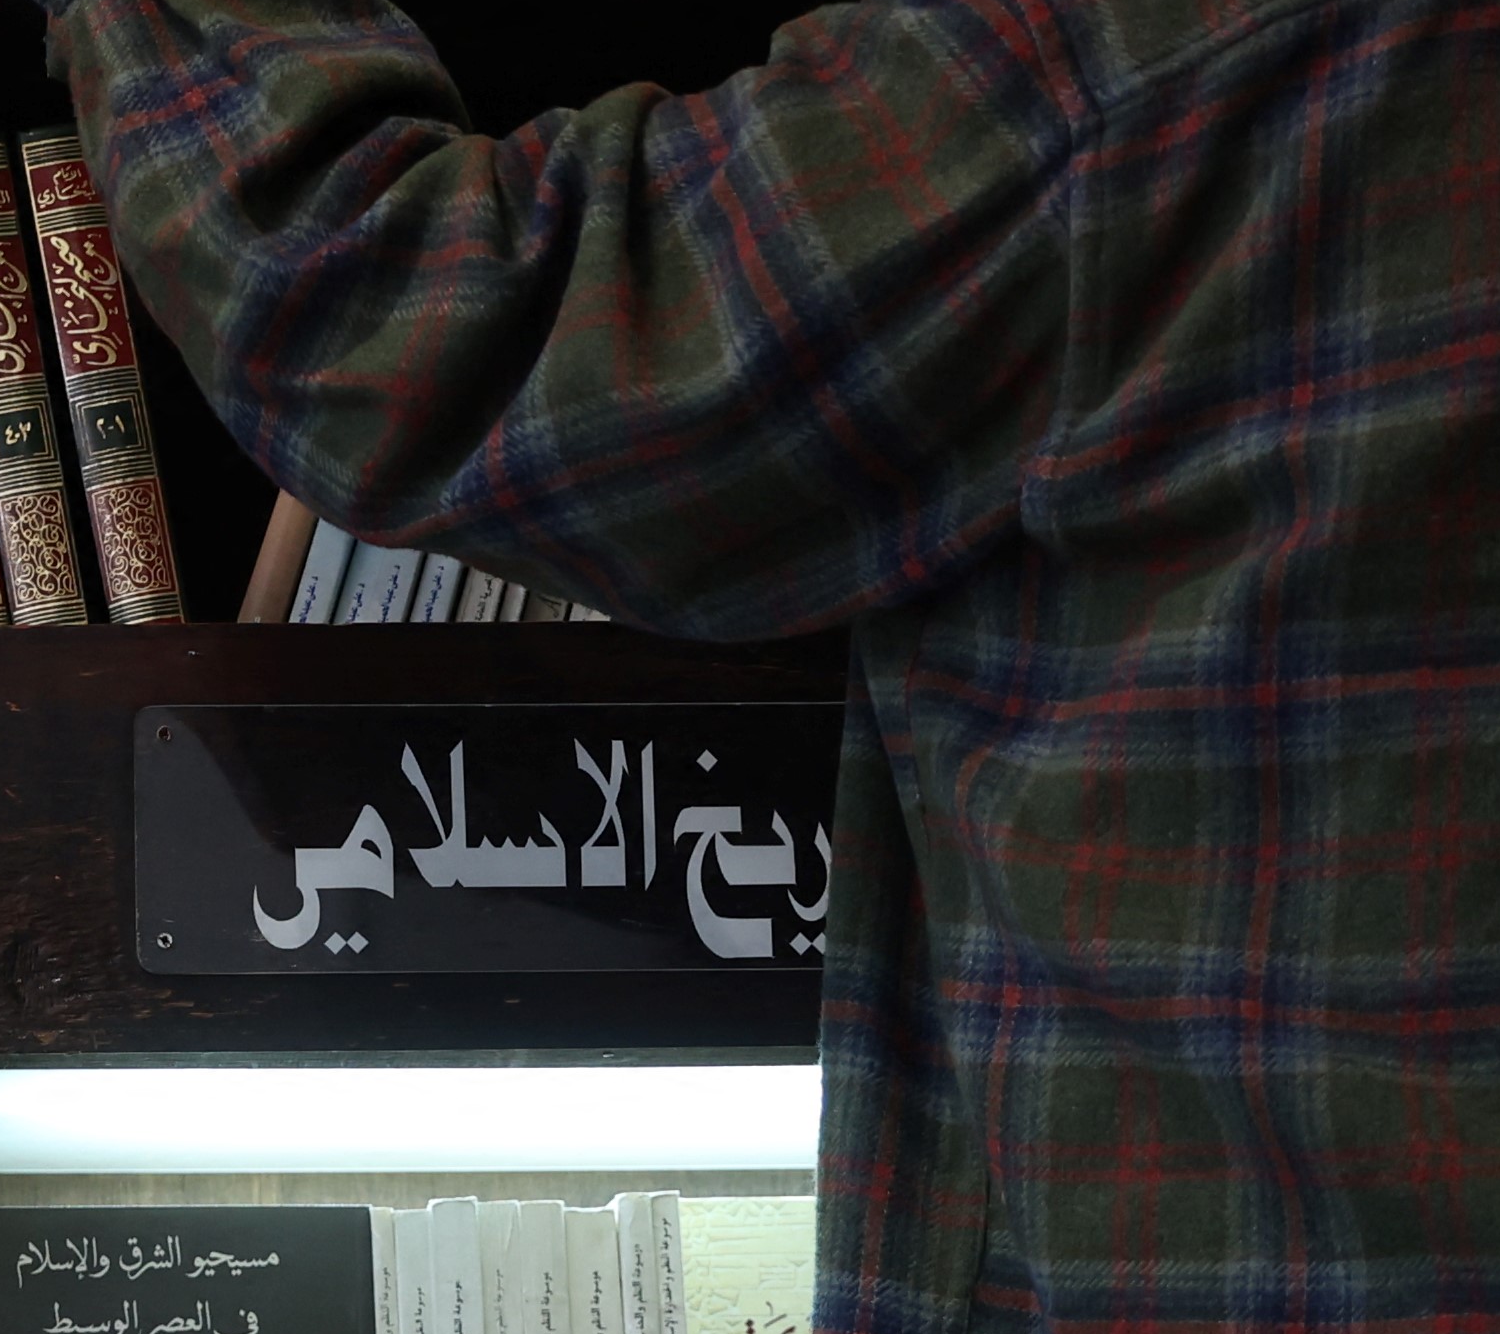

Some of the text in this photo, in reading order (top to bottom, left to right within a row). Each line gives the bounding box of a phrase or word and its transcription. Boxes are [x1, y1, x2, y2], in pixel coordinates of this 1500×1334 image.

[15, 1234, 280, 1289] مسيحيو الشرق والإسلام
